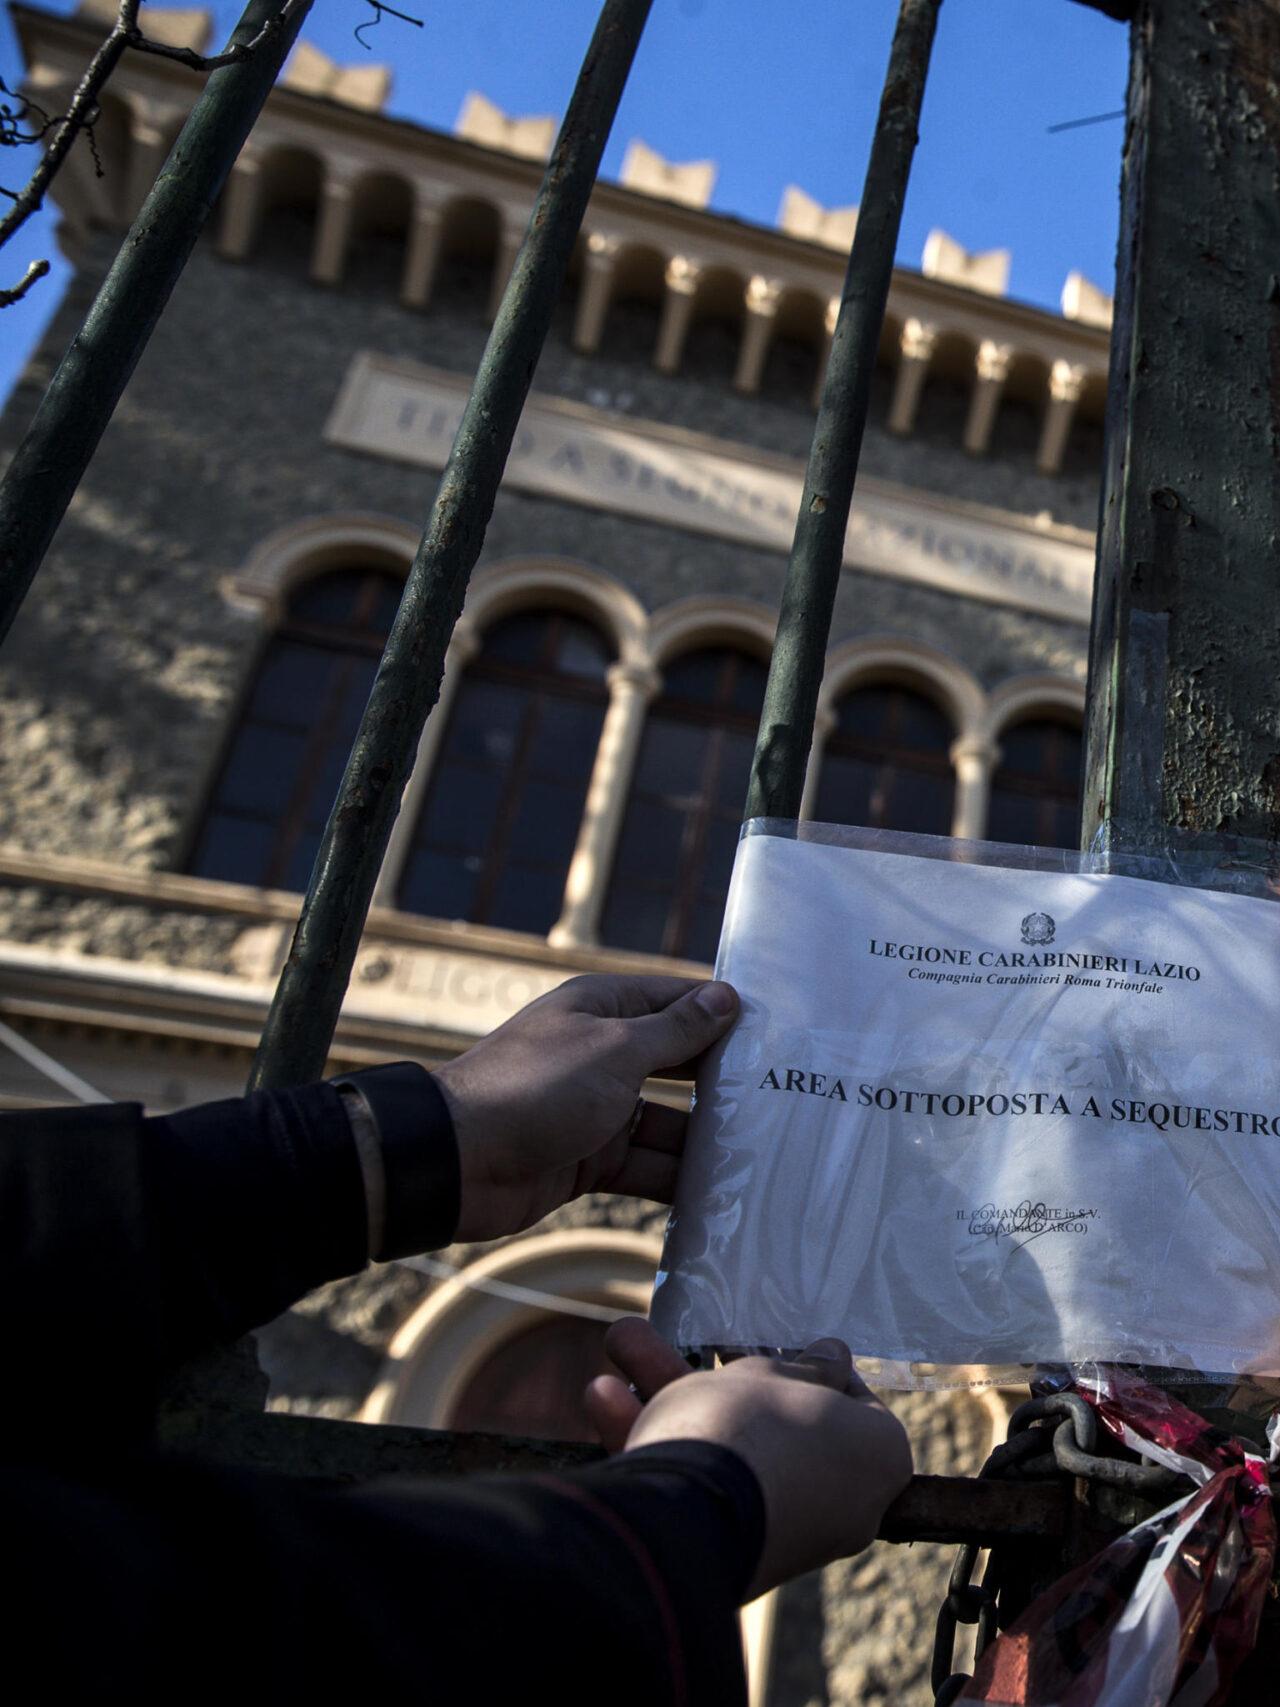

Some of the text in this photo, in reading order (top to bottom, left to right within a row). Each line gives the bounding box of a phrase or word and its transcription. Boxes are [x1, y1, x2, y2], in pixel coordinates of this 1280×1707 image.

[869, 939, 1201, 982] LEGIONE CARABINIERI LAZIO
[908, 968, 1163, 994] Compagnia Carabinieri Roma Trionfale
[758, 1068, 848, 1101] AREA
[857, 1084, 1072, 1117] SOTTOPOSTA
[1080, 1096, 1101, 1118] A
[956, 1209, 968, 1220] IL
[971, 1207, 1062, 1220] COMANDANTE
[1065, 1207, 1075, 1219] in
